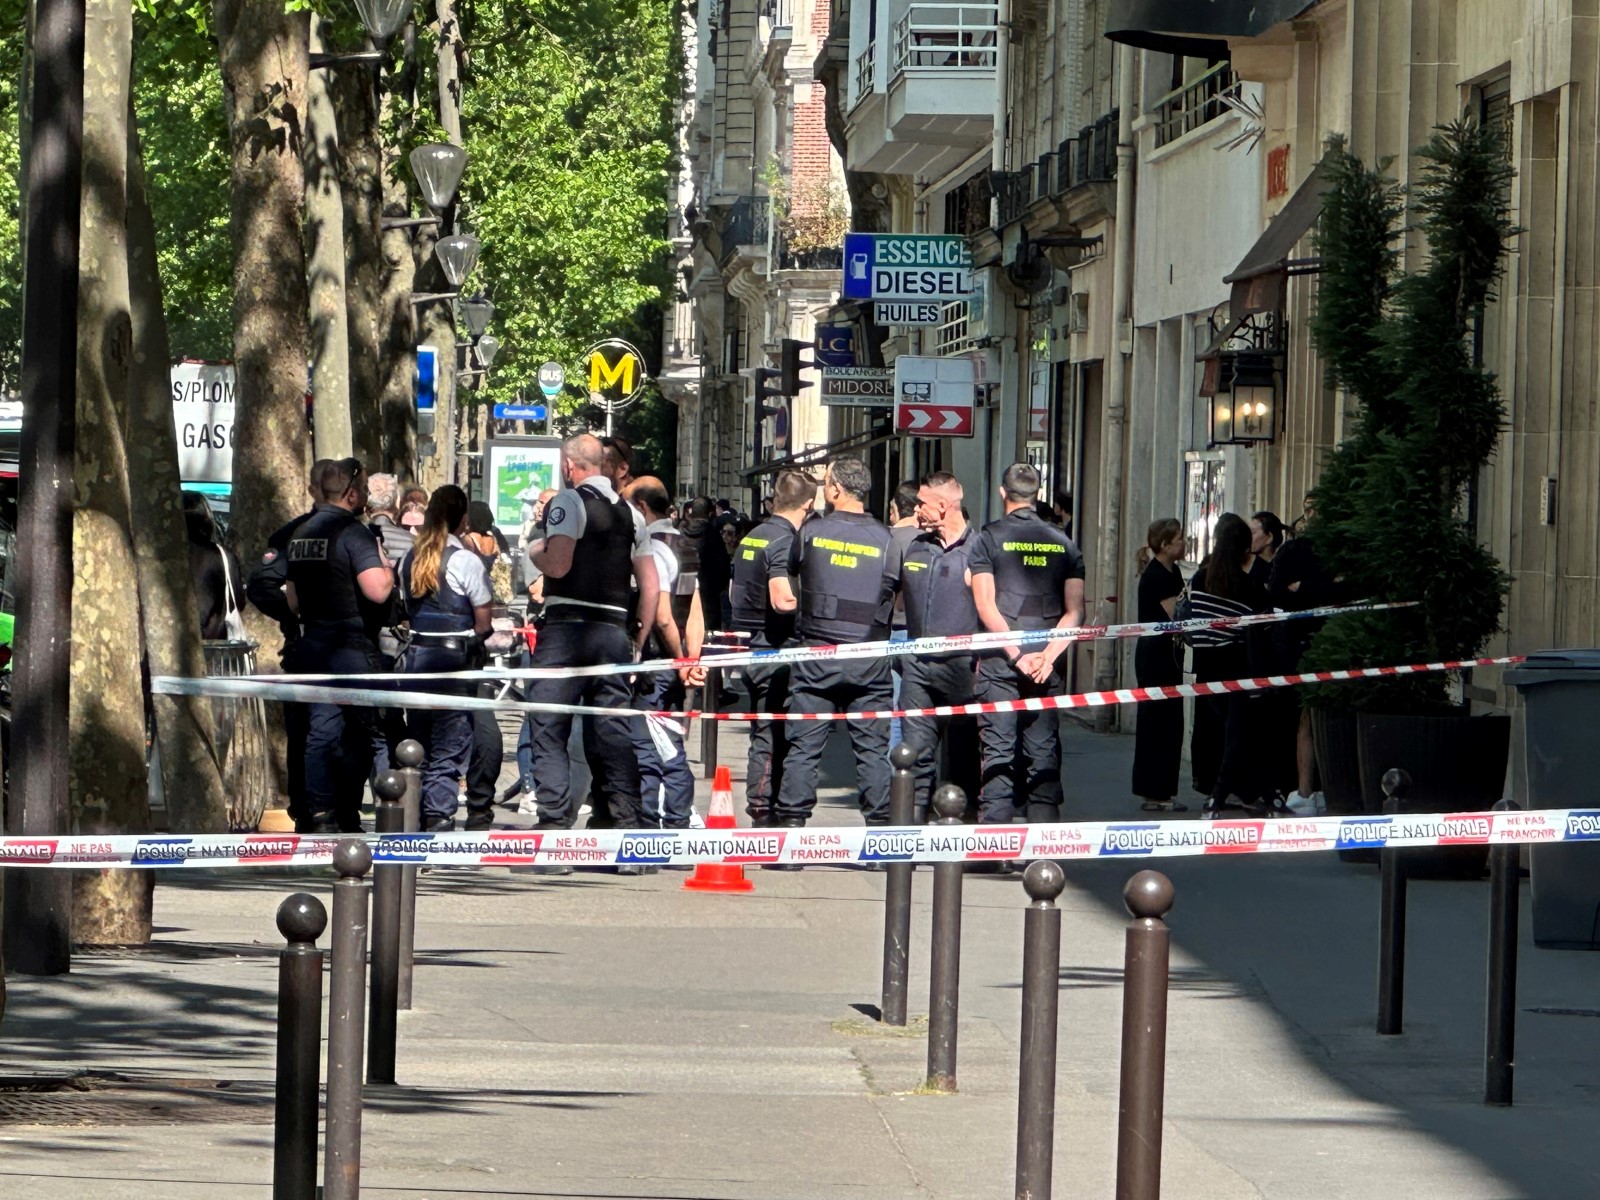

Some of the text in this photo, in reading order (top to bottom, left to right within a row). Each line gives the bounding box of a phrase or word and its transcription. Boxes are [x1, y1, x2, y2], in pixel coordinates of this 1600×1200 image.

[875, 240, 972, 264] ESSENCE
[876, 271, 973, 294] DIESEL
[878, 305, 939, 322] HUILES
[540, 369, 562, 382] BUS
[590, 351, 634, 395] M
[183, 422, 234, 449] GAS
[1525, 815, 1546, 826] PAS
[1041, 828, 1082, 841] NE PAS
[1277, 824, 1293, 835] NE
[1343, 821, 1488, 841] POLICE NATIONALE
[1500, 829, 1556, 840] FRANCHIR
[556, 837, 598, 848] NE PAS
[800, 834, 841, 845] NE PAS
[868, 835, 1018, 853] POLICE NATIONALE
[1108, 828, 1256, 848] POLICE NATIONALE
[71, 843, 113, 854] NE PAS
[139, 845, 196, 860] POLICE
[202, 843, 293, 858] NATIONALE
[384, 840, 534, 855] POLICE NATIONALE
[624, 839, 777, 856] POLICE NATIONALE
[791, 849, 851, 860] FRANCHIR
[1032, 843, 1091, 855] FRANCHIR
[547, 850, 607, 861] FRANCHIR
